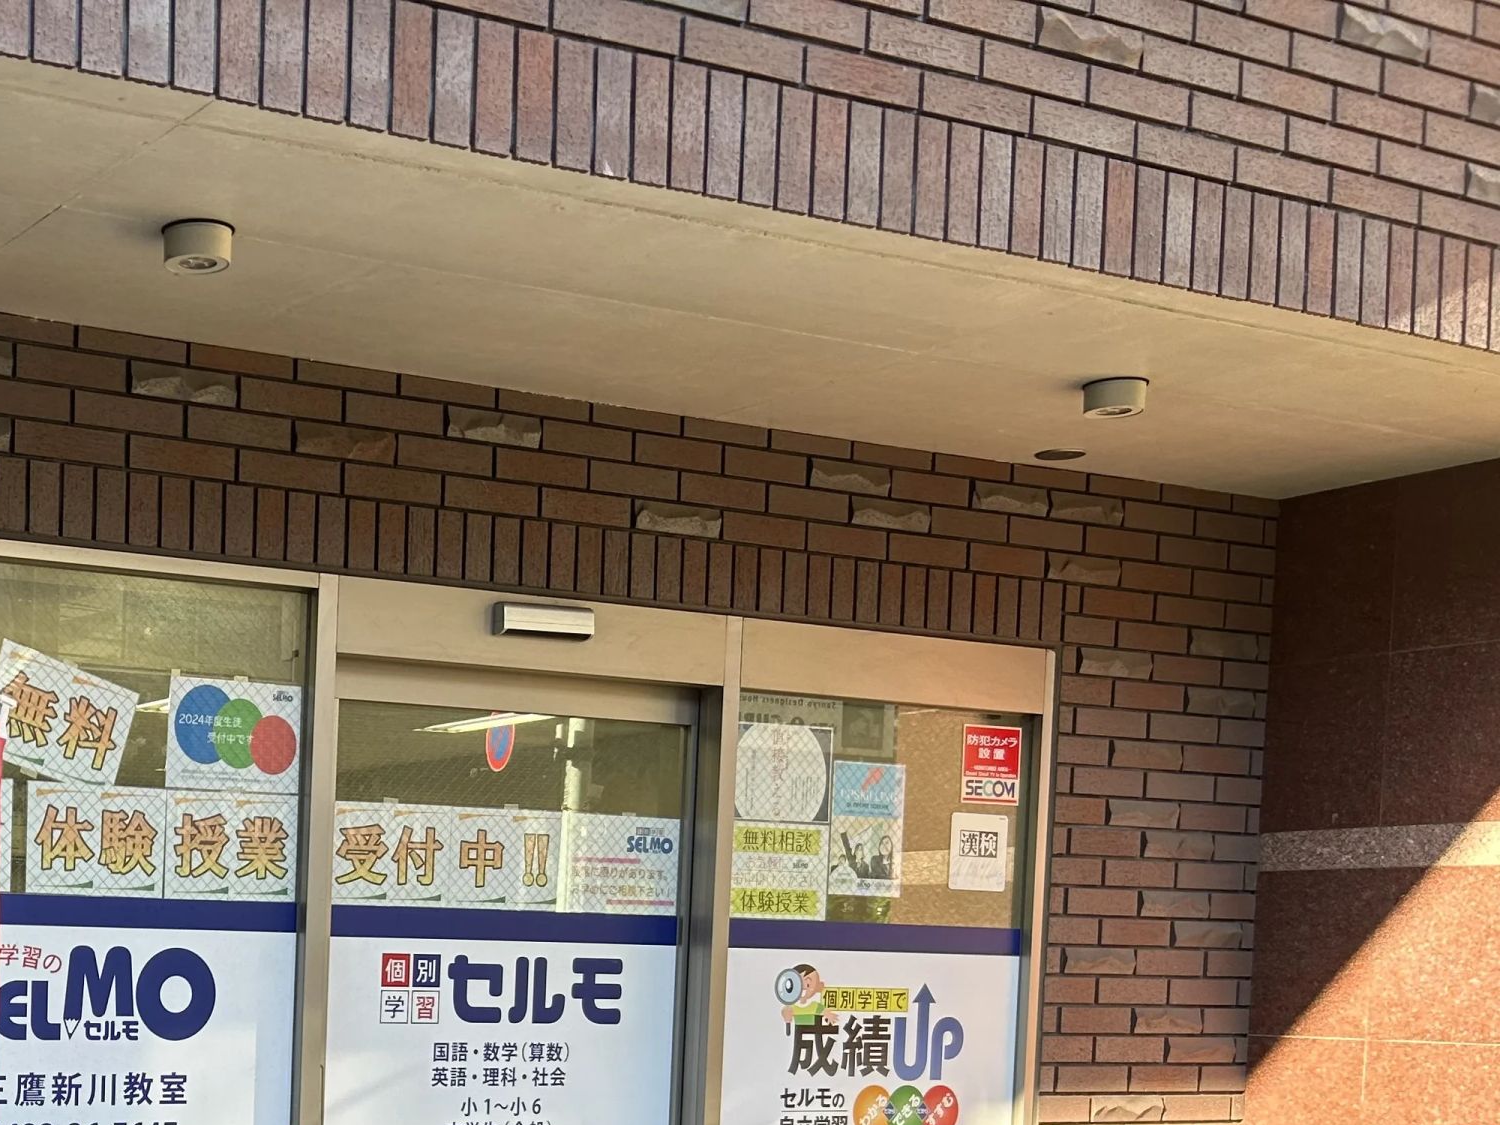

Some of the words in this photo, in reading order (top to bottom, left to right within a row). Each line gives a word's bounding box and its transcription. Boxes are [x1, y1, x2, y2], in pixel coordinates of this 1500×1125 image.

[2, 671, 119, 770] 無料
[179, 713, 242, 728] 2024年度生徒
[967, 734, 1018, 748] 防犯カメラ
[978, 748, 1006, 761] 設置
[965, 780, 1015, 798] SECOM
[36, 804, 288, 879] 体験授業
[627, 836, 673, 854] SELMO
[742, 829, 812, 853] 無料相談
[960, 831, 998, 857] 漢検
[740, 890, 810, 913] 体験授業
[383, 957, 439, 986] 個別
[448, 955, 623, 1024] セルモ
[823, 989, 908, 1011] 個別学習で
[382, 995, 437, 1020] 学習
[84, 1021, 139, 1041] セルモ
[431, 1067, 567, 1088] 英語・理科・社会
[780, 1088, 845, 1109] セルモの
